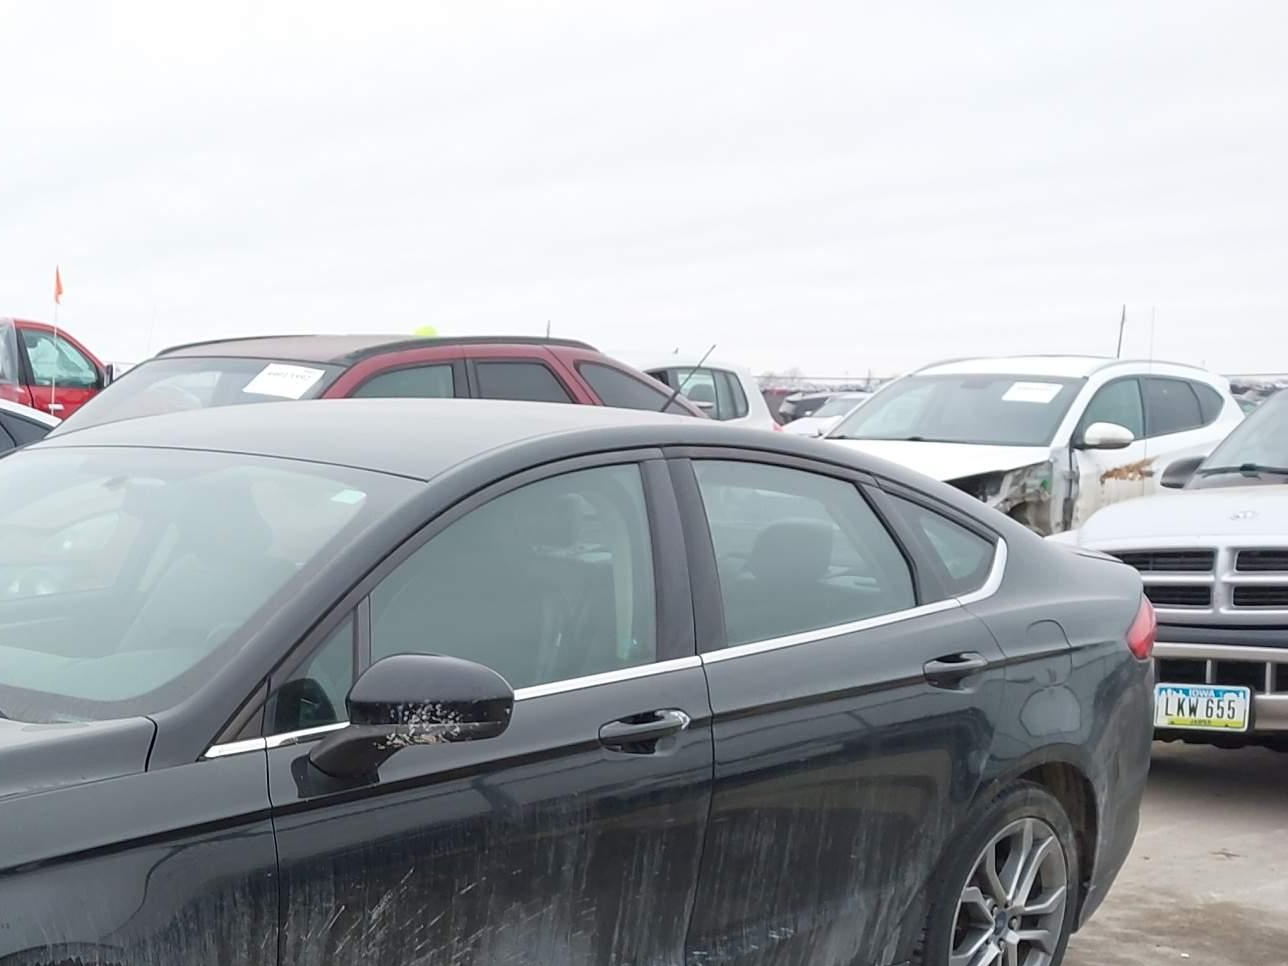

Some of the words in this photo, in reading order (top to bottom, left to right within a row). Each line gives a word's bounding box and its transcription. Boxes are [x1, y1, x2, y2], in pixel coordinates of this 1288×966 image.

[1189, 688, 1215, 698] IOWA
[1165, 697, 1198, 717] LKW
[1206, 699, 1235, 719] 655
